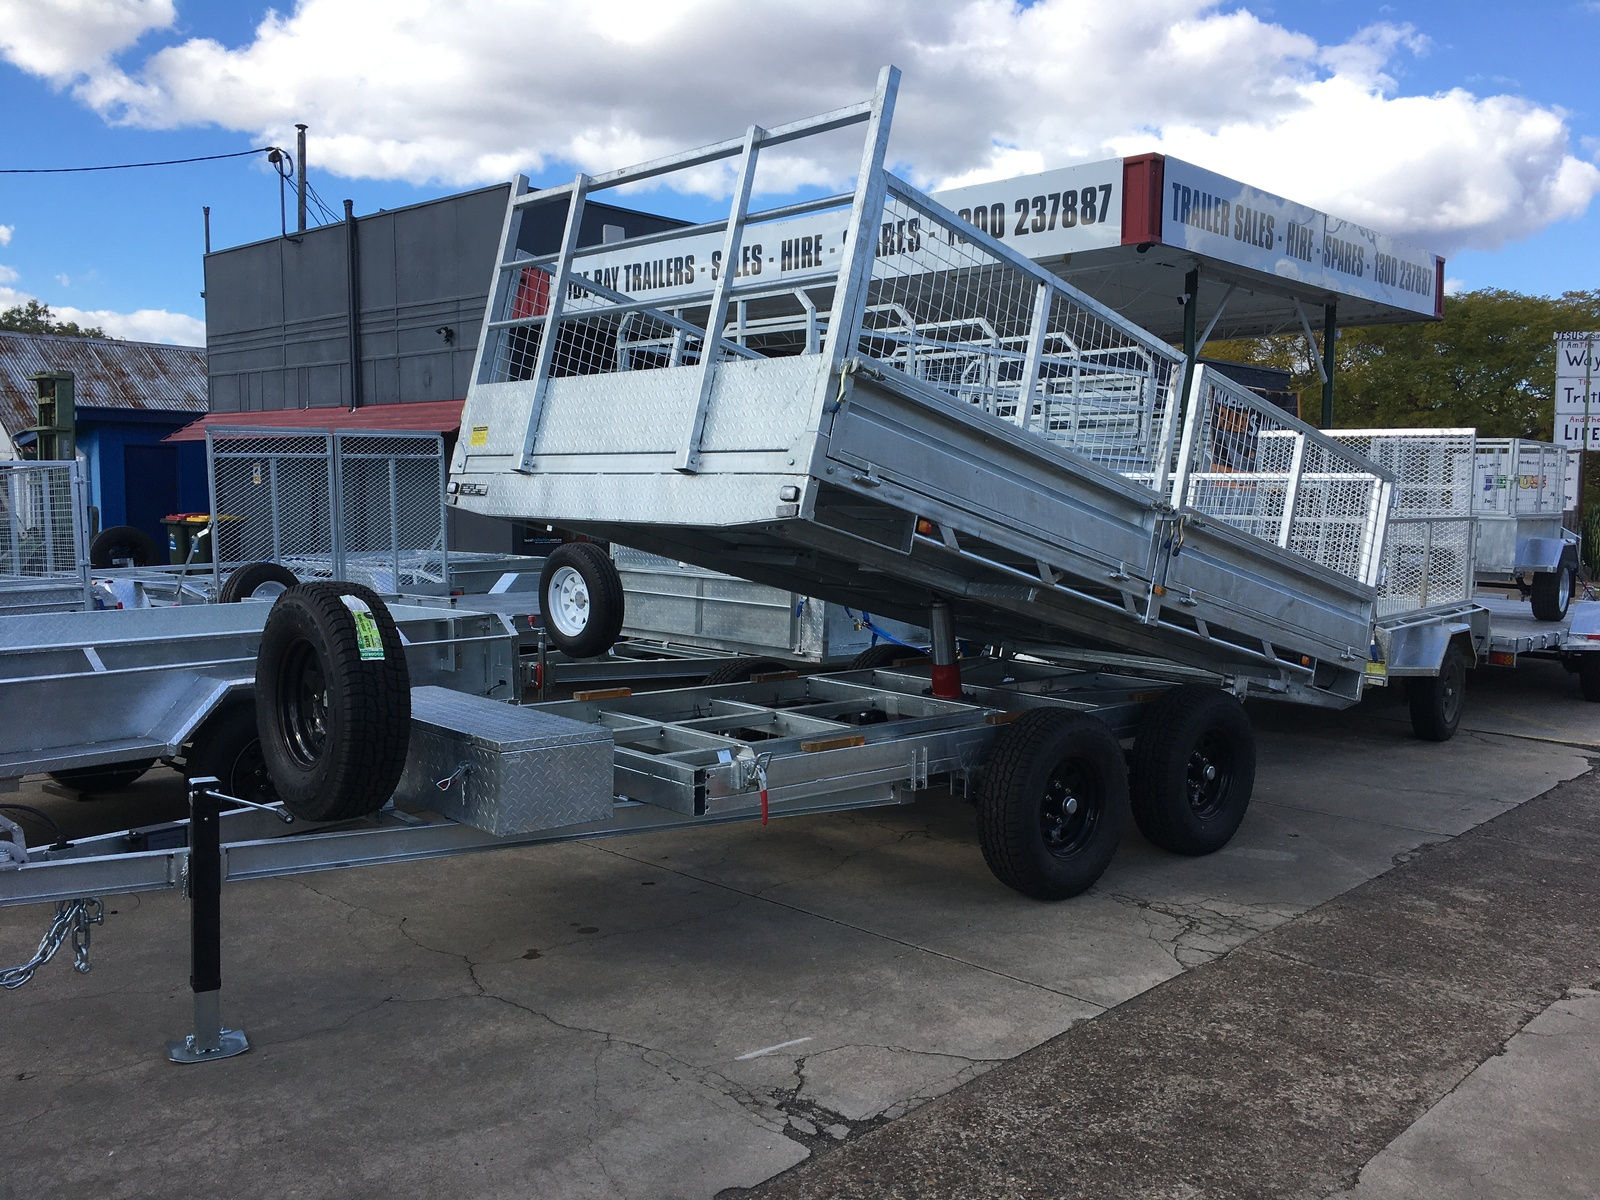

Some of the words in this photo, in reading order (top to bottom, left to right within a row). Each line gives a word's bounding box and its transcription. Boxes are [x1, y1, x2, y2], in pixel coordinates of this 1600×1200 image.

[624, 254, 695, 293] TRAILERS
[711, 243, 763, 281] SLES
[781, 233, 823, 272] HIRE
[1014, 183, 1113, 236] 237887
[1172, 182, 1231, 237] TRAILER
[1234, 204, 1275, 251] SALES
[1285, 221, 1314, 263] HIRE
[1323, 235, 1365, 278] SPARES
[1374, 251, 1398, 288] 1300
[1399, 260, 1433, 297] 237887
[1556, 331, 1584, 340] JESUS
[1569, 415, 1585, 423] And
[1484, 474, 1547, 491] JEUS
